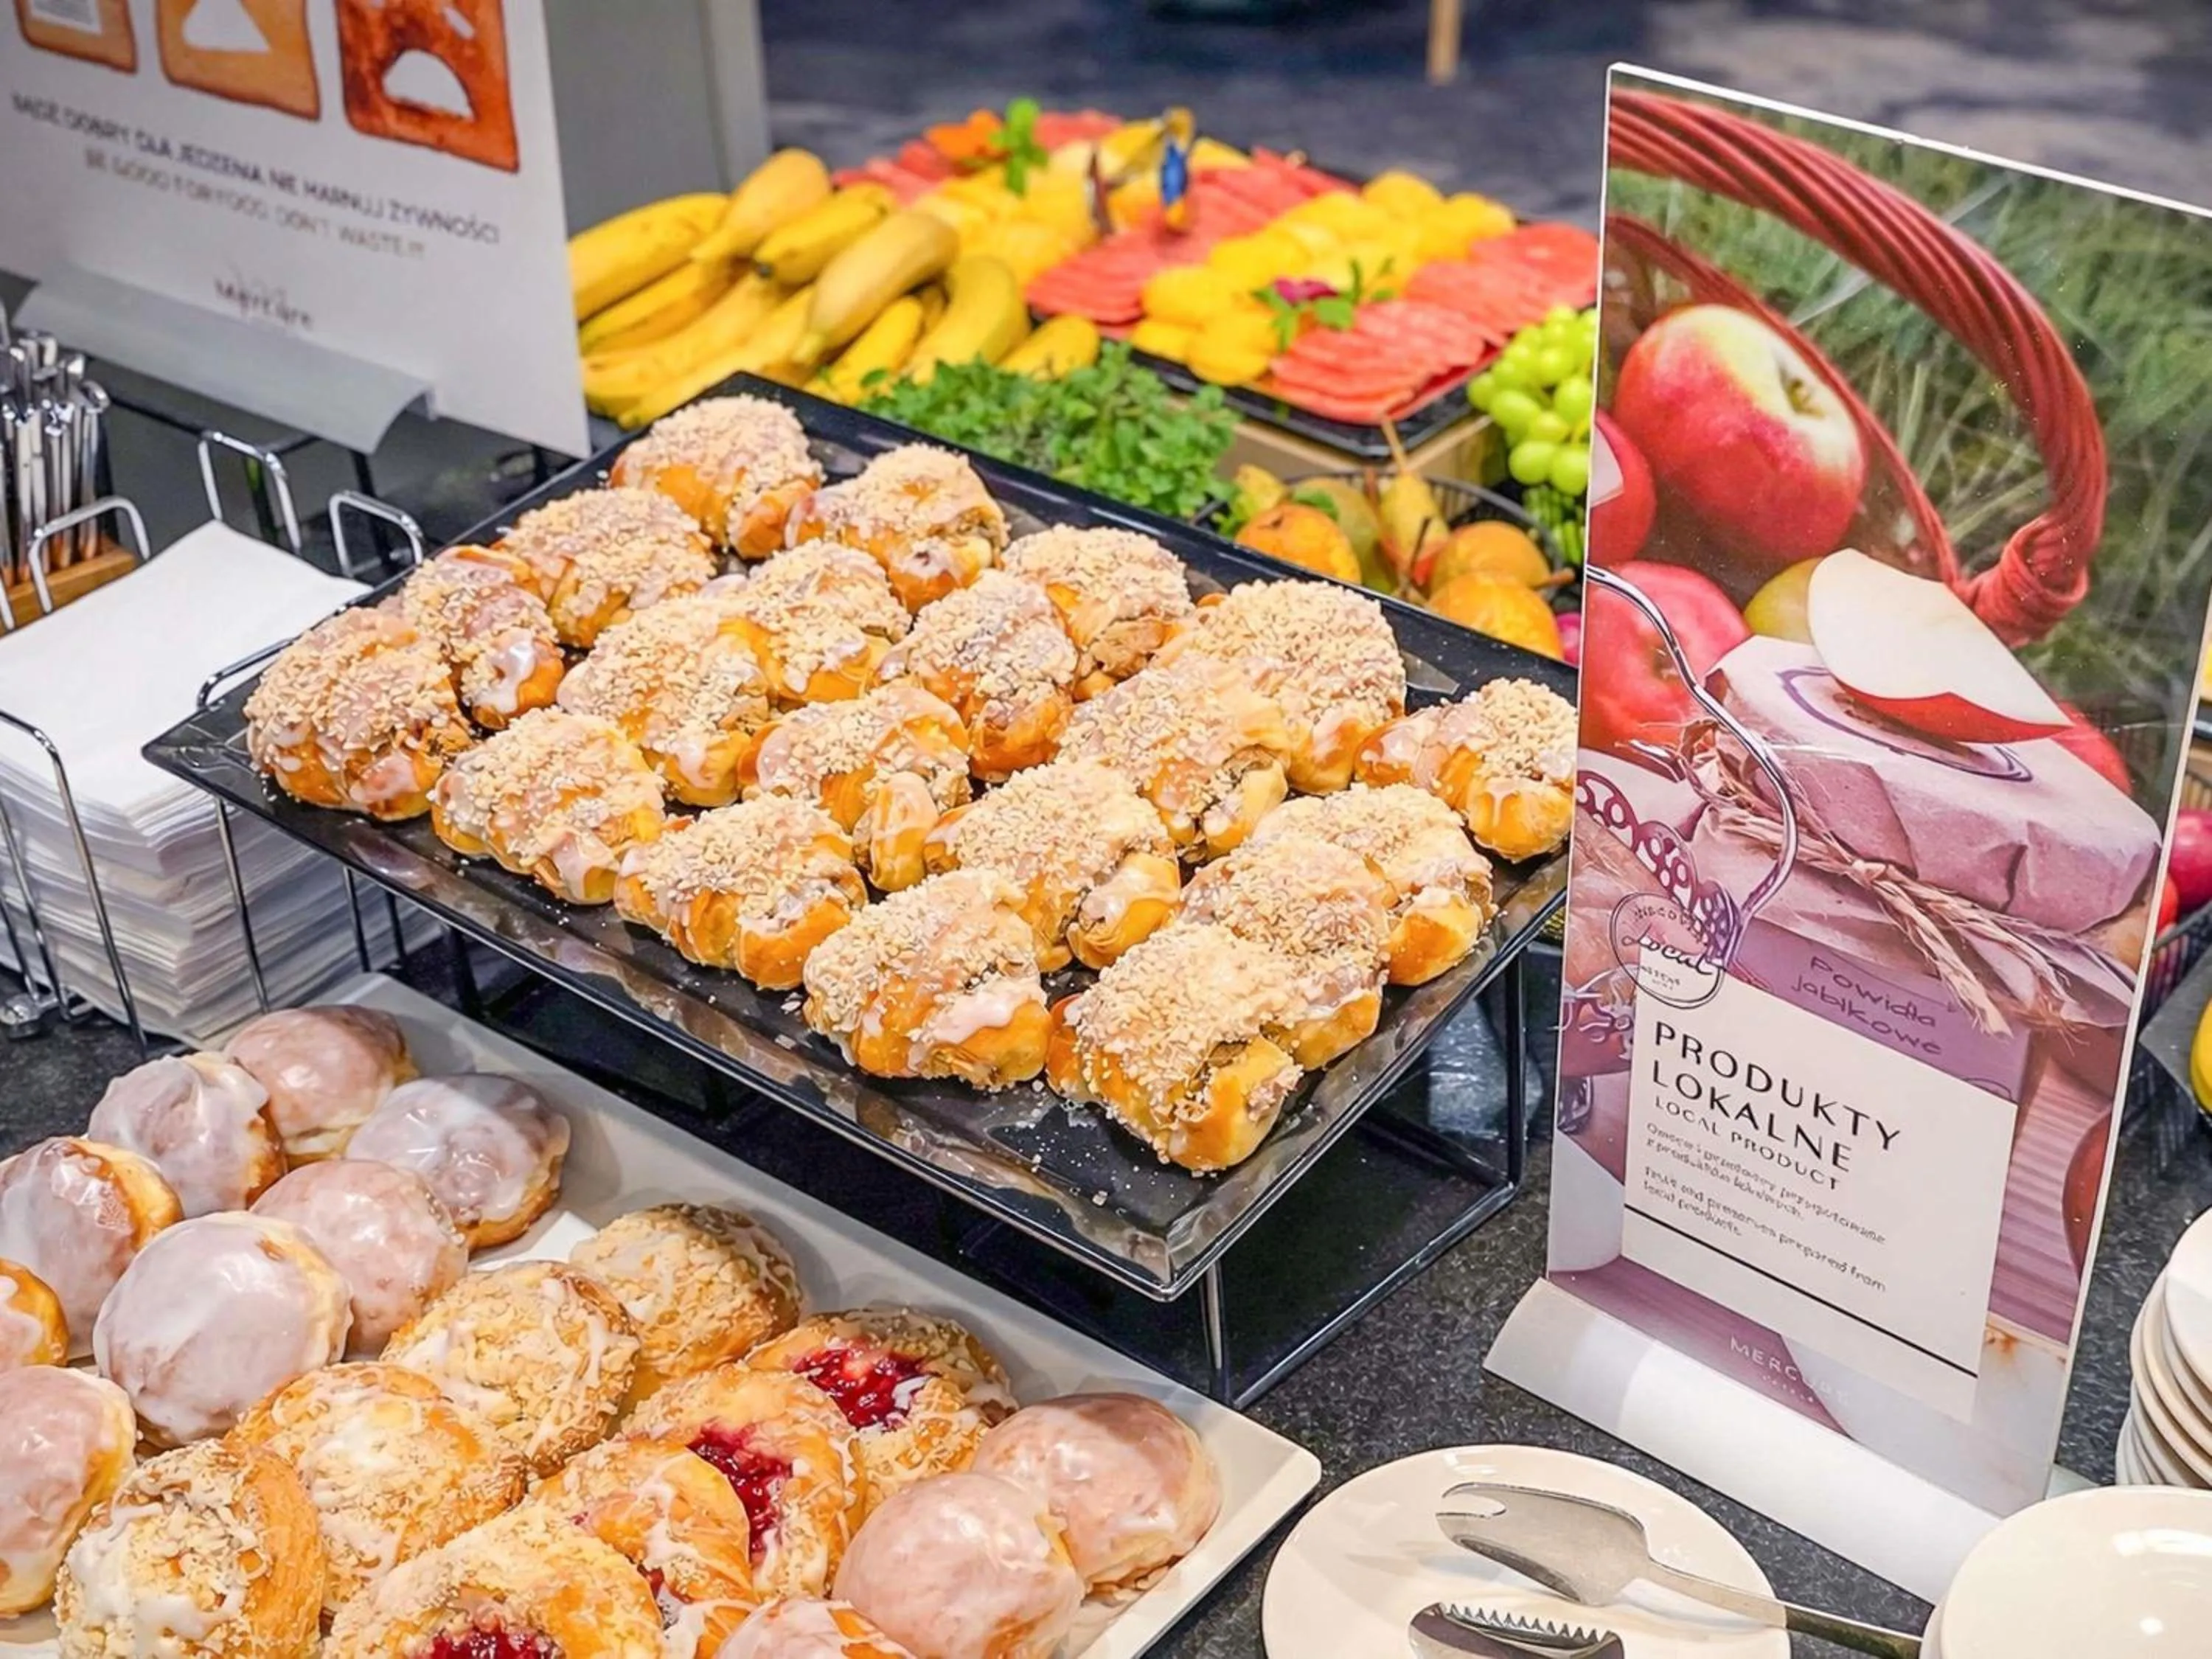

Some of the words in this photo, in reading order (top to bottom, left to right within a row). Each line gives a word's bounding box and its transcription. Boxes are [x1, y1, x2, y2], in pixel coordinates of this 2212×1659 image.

[1653, 1060, 1852, 1172] LOKALNE
[1655, 1020, 1901, 1150] PRODUKTY
[1655, 1096, 1721, 1136] LOCAL
[1731, 1132, 1840, 1190] PRODUCT
[1779, 1233, 1848, 1273] prepared
[1850, 1265, 1886, 1292] from
